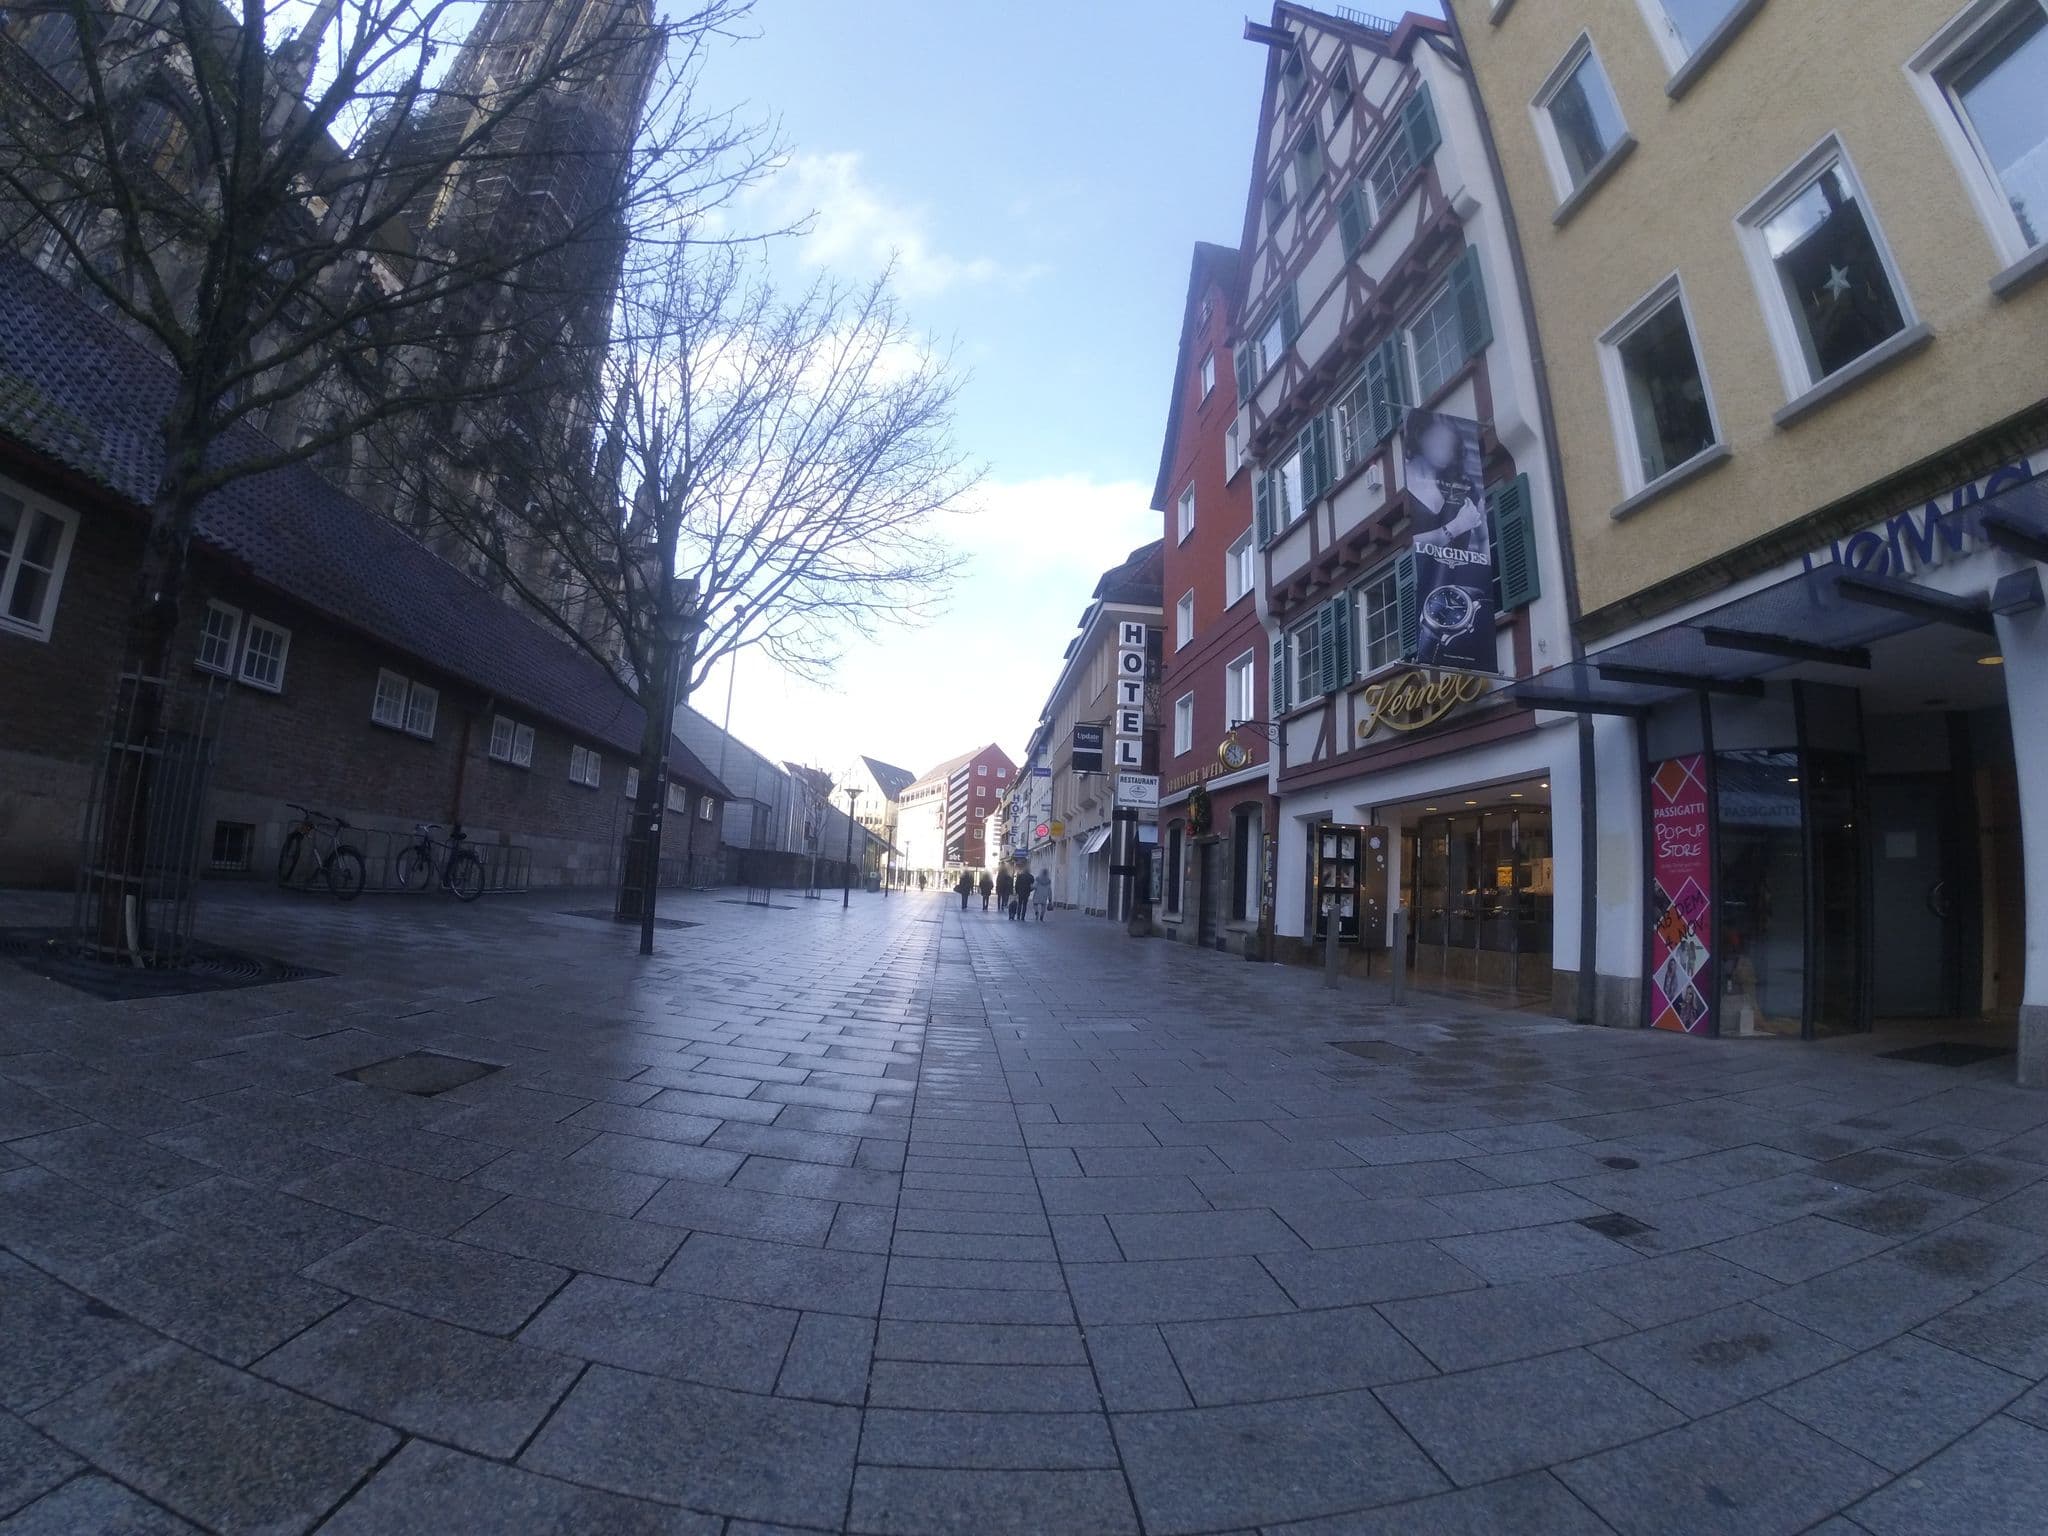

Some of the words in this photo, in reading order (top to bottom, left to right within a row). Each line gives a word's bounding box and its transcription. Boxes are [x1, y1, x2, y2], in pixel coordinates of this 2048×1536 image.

[1415, 541, 1489, 566] LONGINES
[1122, 624, 1143, 763] HOTEL
[1077, 731, 1100, 742] Update
[1120, 775, 1158, 786] RESTAURANT
[1010, 793, 1021, 844] HOTEL
[1654, 802, 1706, 819] PASSIGATTI
[1658, 840, 1703, 858] STORE
